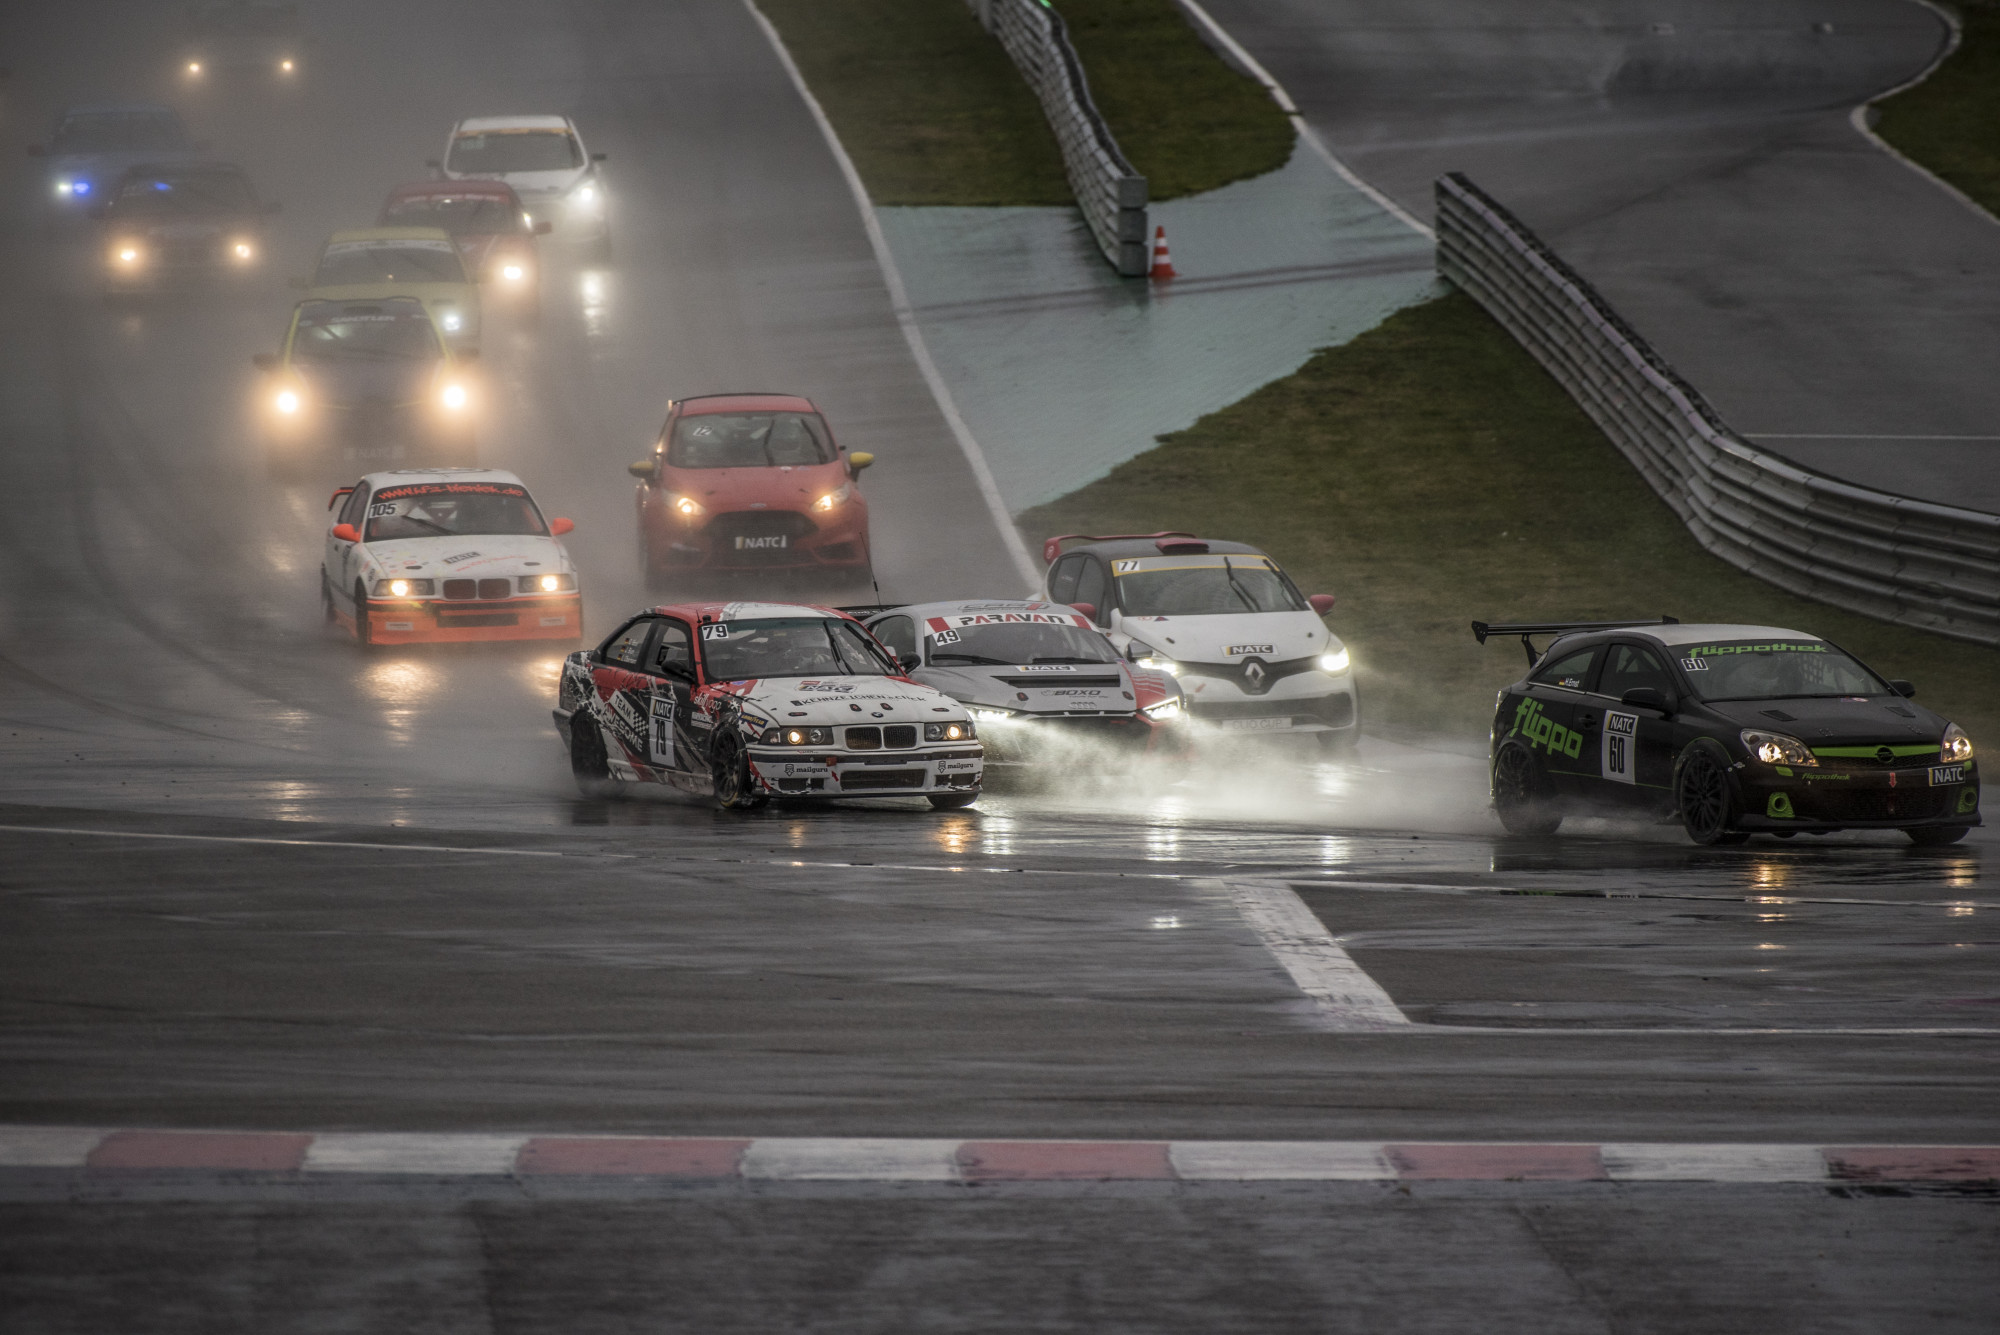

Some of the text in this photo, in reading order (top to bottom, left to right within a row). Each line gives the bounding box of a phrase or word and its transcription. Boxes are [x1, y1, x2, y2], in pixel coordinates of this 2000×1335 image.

[370, 503, 396, 516] 105
[745, 537, 780, 549] NATC
[1120, 561, 1138, 571] 77
[959, 613, 1066, 626] PARAVAN
[702, 625, 728, 640] 79
[936, 629, 960, 644] 49
[1231, 645, 1273, 654] NATC
[1687, 643, 1829, 659] flippothek
[1683, 658, 1707, 671] 60
[614, 694, 632, 720] TEAM
[654, 700, 673, 719] NATC
[602, 706, 644, 753] AWESOME
[1509, 696, 1584, 760] flippo
[1610, 715, 1634, 732] NATC
[655, 719, 667, 756] 79
[1609, 735, 1625, 774] 60
[796, 766, 828, 774] mailguru
[947, 762, 974, 770] mailguru
[1934, 767, 1964, 785] NATC
